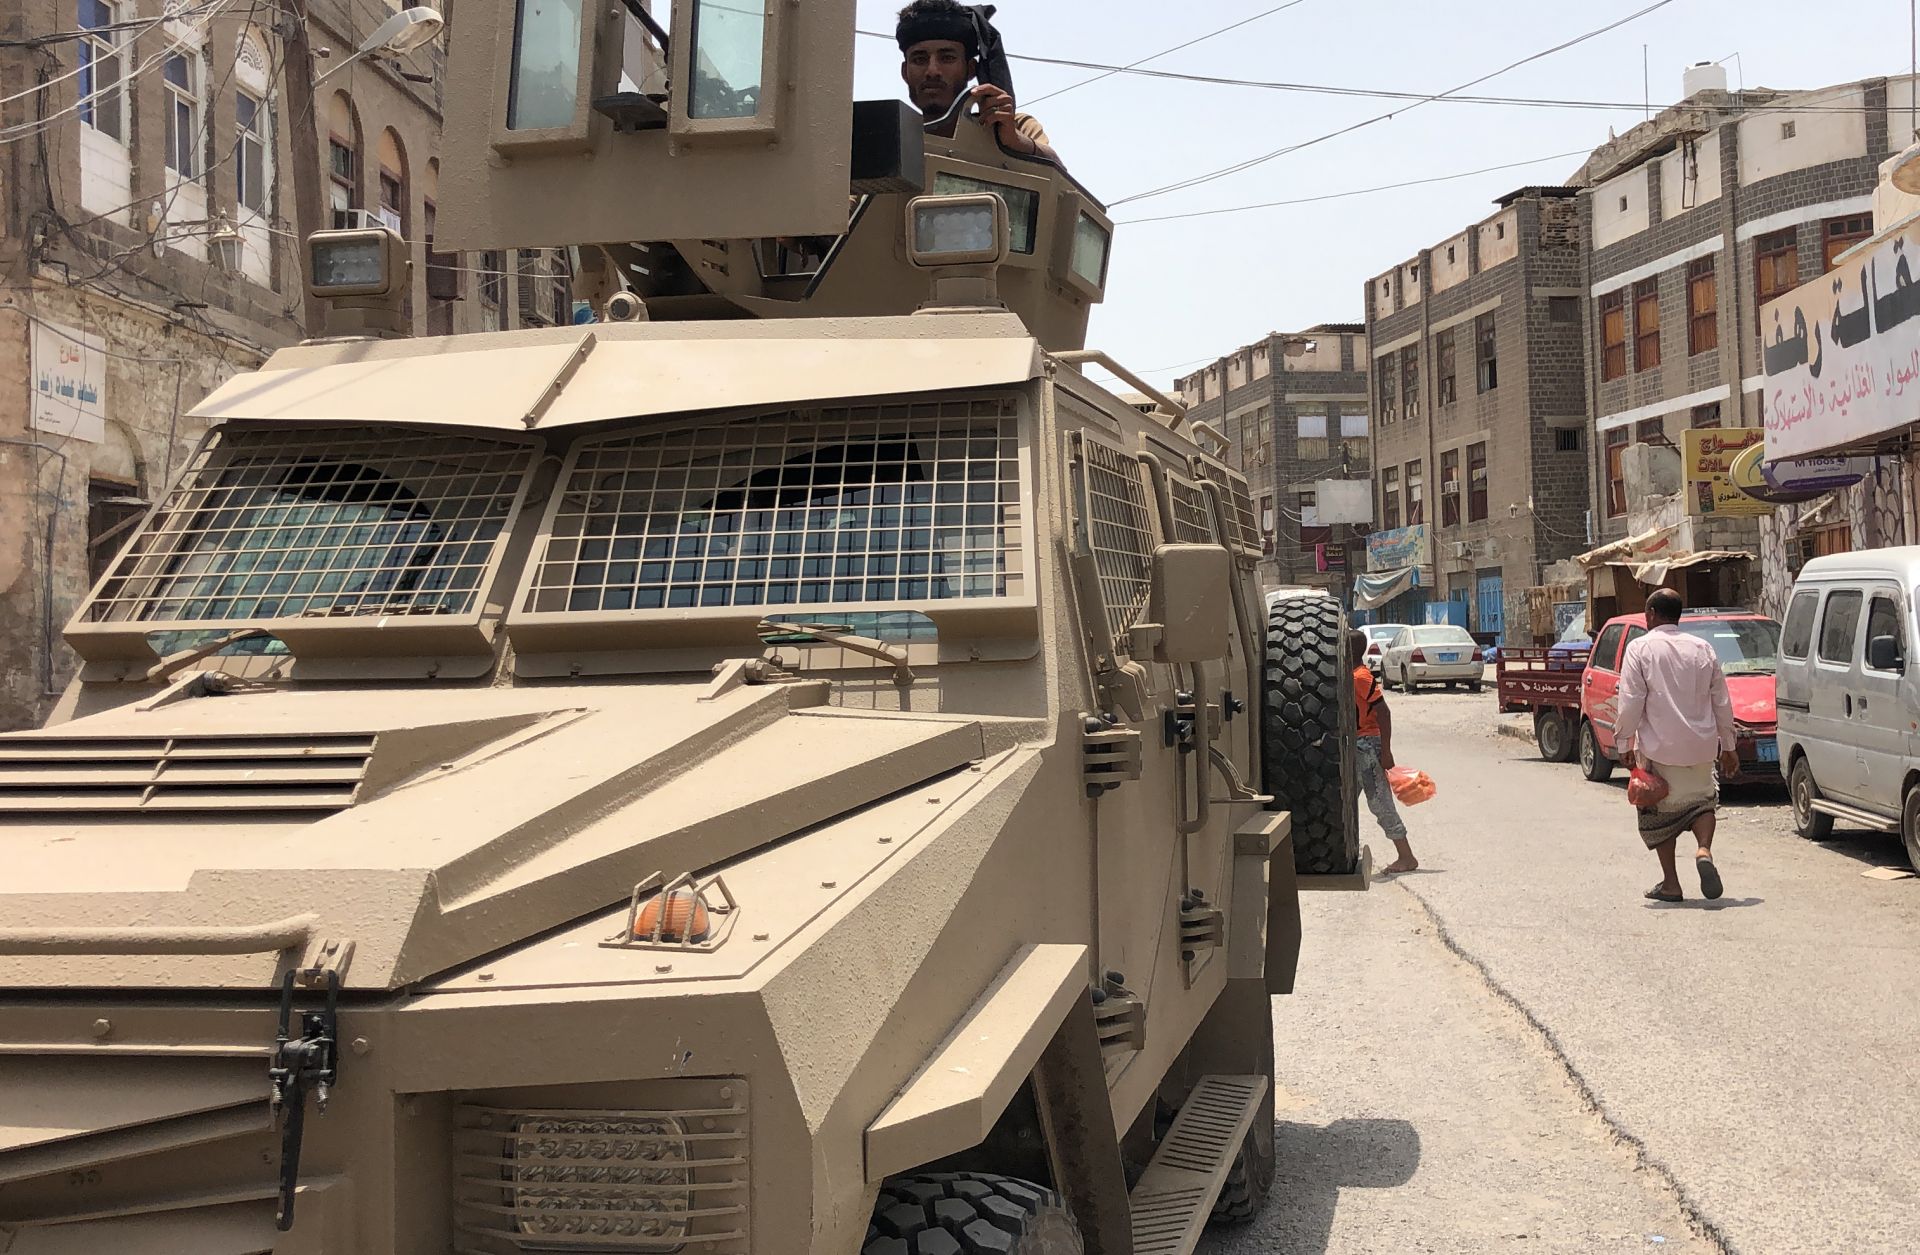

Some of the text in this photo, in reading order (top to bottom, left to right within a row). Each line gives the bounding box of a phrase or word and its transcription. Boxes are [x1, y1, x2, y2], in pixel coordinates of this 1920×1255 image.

[1764, 236, 1920, 379] قالة رهف
[60, 344, 80, 364] شارع
